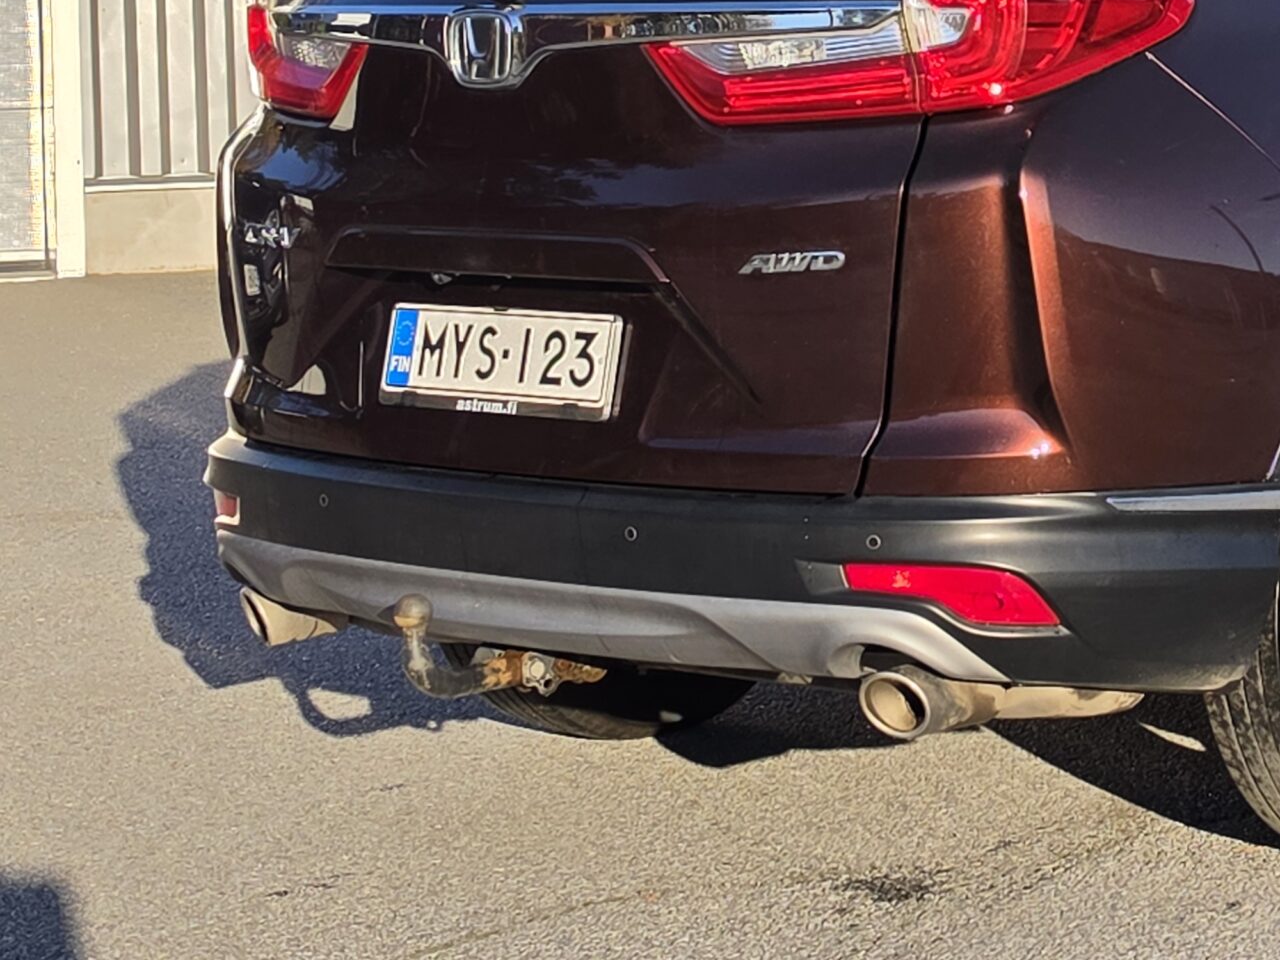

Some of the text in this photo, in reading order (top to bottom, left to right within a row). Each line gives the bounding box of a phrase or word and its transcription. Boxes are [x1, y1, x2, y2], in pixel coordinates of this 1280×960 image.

[738, 250, 846, 275] AWD
[389, 355, 412, 374] FIN
[455, 398, 518, 416] astrum.fi
